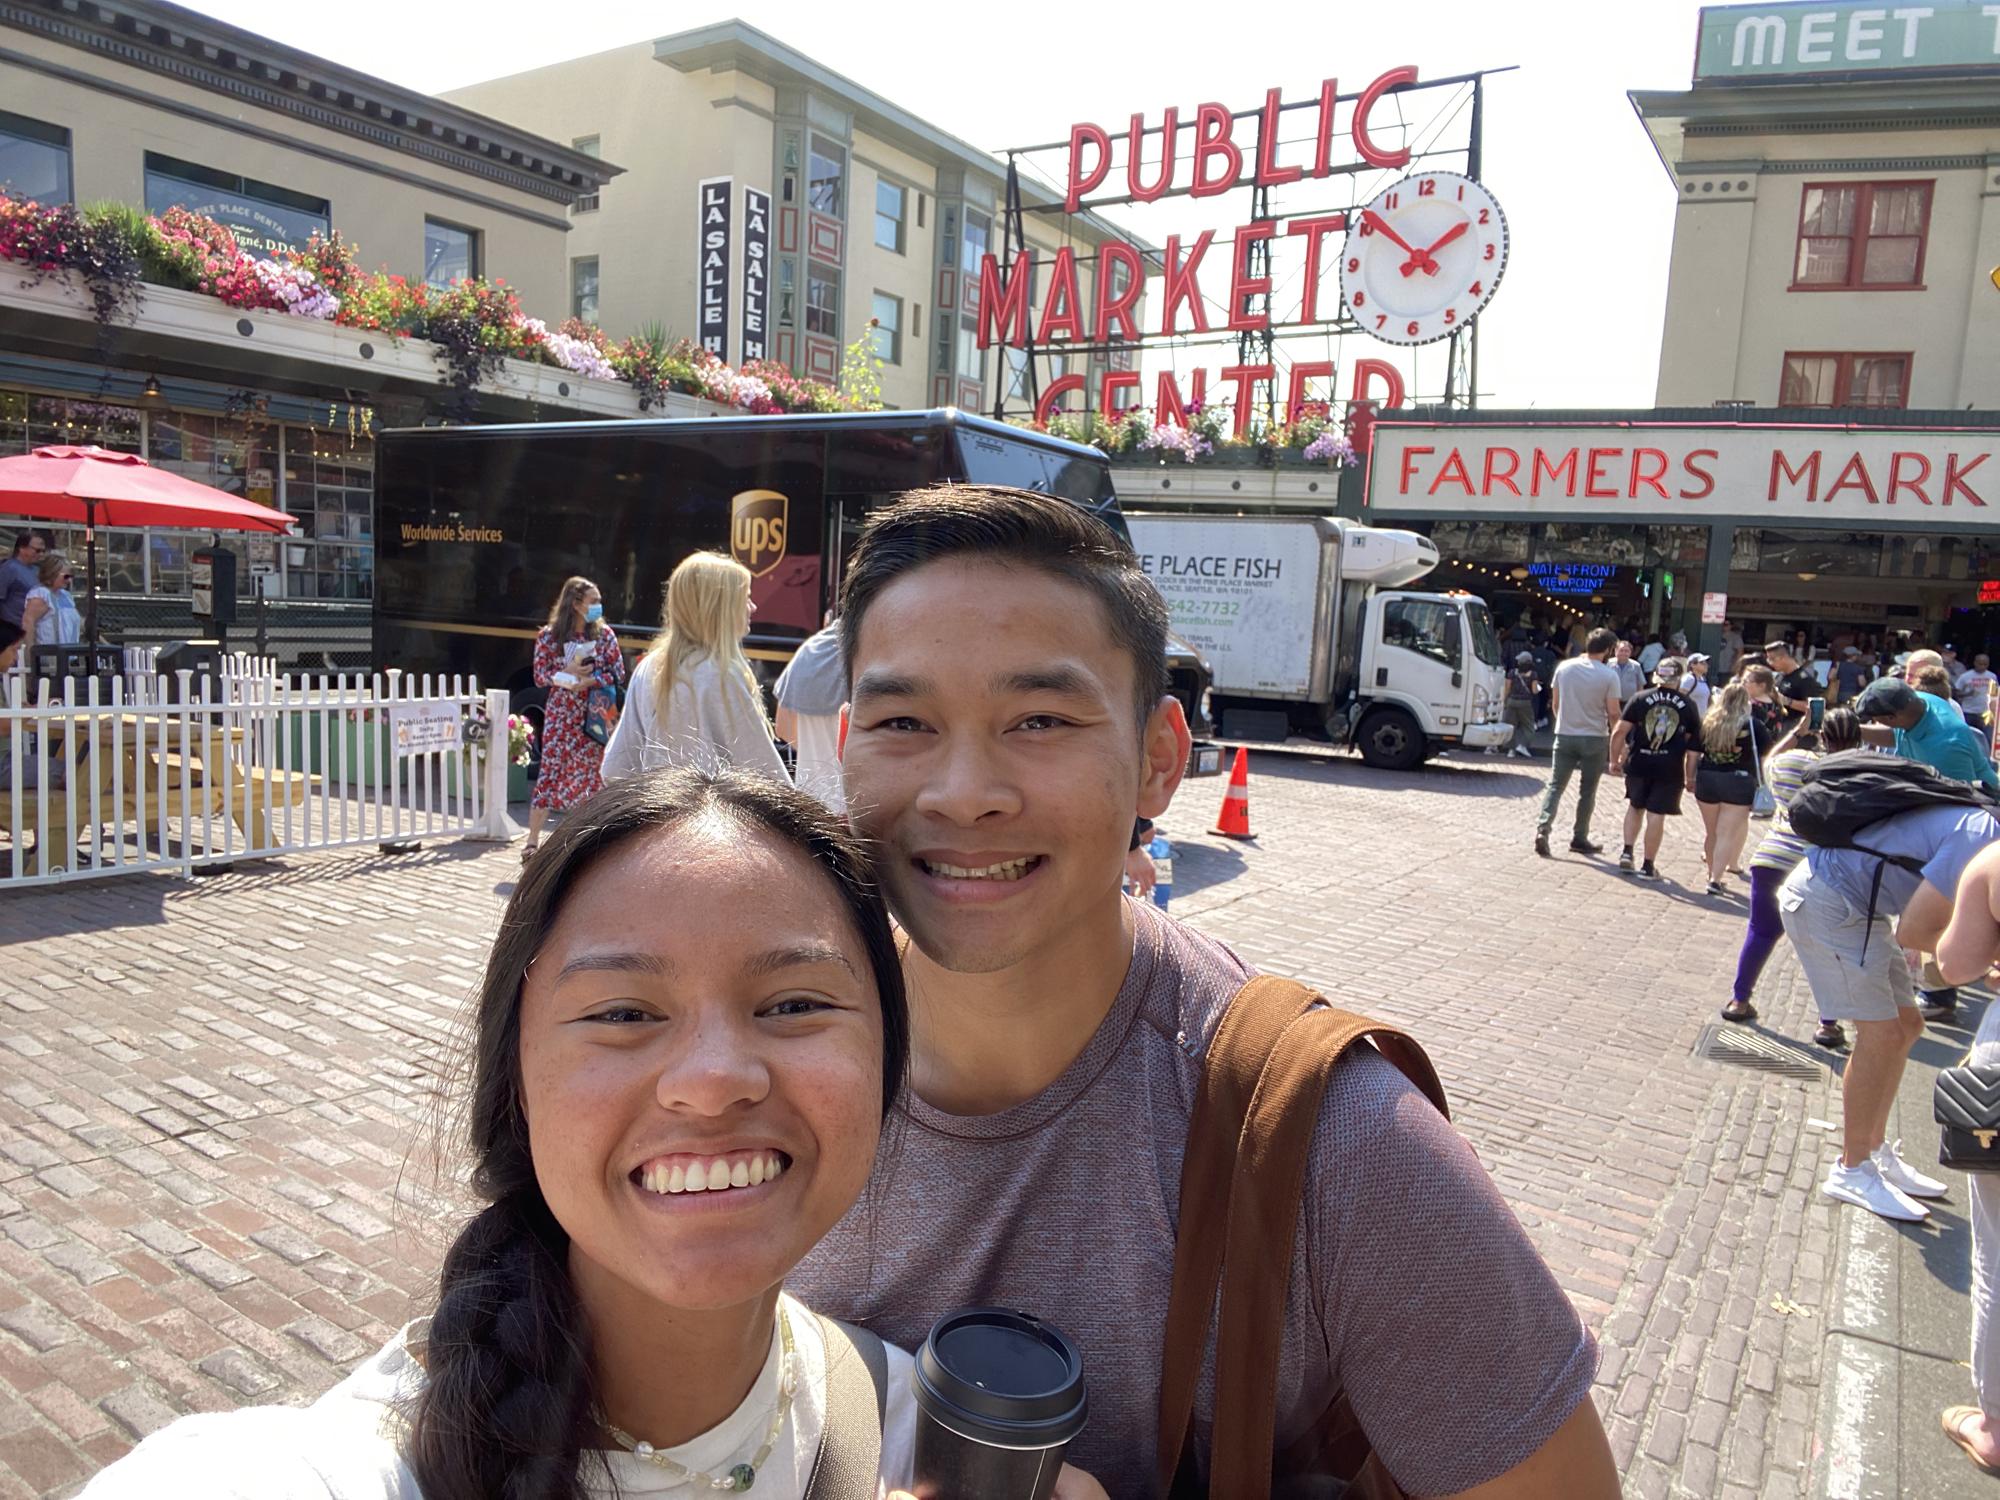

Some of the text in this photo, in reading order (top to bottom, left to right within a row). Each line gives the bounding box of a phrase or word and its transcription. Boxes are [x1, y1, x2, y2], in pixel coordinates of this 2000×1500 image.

[1731, 7, 1934, 66] MEET
[1064, 64, 1419, 213] PUBLIC
[1418, 179, 1436, 197] 12
[1458, 185, 1464, 201] 1
[704, 188, 726, 225] LA
[1385, 193, 1398, 210] 11
[219, 203, 250, 218] PLACE
[253, 211, 288, 239] DENTAL
[748, 194, 766, 234] LA
[1478, 208, 1490, 225] 2
[1359, 222, 1374, 238] 10
[1483, 243, 1495, 260] 3
[1347, 258, 1360, 273] 9
[703, 230, 726, 324] SALLE
[976, 214, 1345, 349] MARKET
[746, 241, 765, 333] SALLE
[1468, 280, 1482, 297] 4
[1353, 291, 1365, 307] 8
[1375, 314, 1387, 330] 7
[1443, 308, 1456, 324] 5
[1407, 321, 1420, 336] 6
[1399, 445, 1992, 507] FARMERS MARK
[400, 523, 503, 543] Worldwide Services
[735, 516, 784, 565] ups
[1160, 555, 1227, 577] PLACE
[1233, 557, 1282, 579] FISH
[1154, 576, 1177, 584] CLOCK
[1189, 577, 1201, 585] THE
[1203, 578, 1218, 586] PIKE
[1220, 579, 1242, 587] PLACE
[1243, 580, 1273, 588] MARKET
[1538, 576, 1605, 589] VIEWPOINT
[1167, 599, 1240, 616] 542-7732
[398, 715, 454, 727] Public Seating
